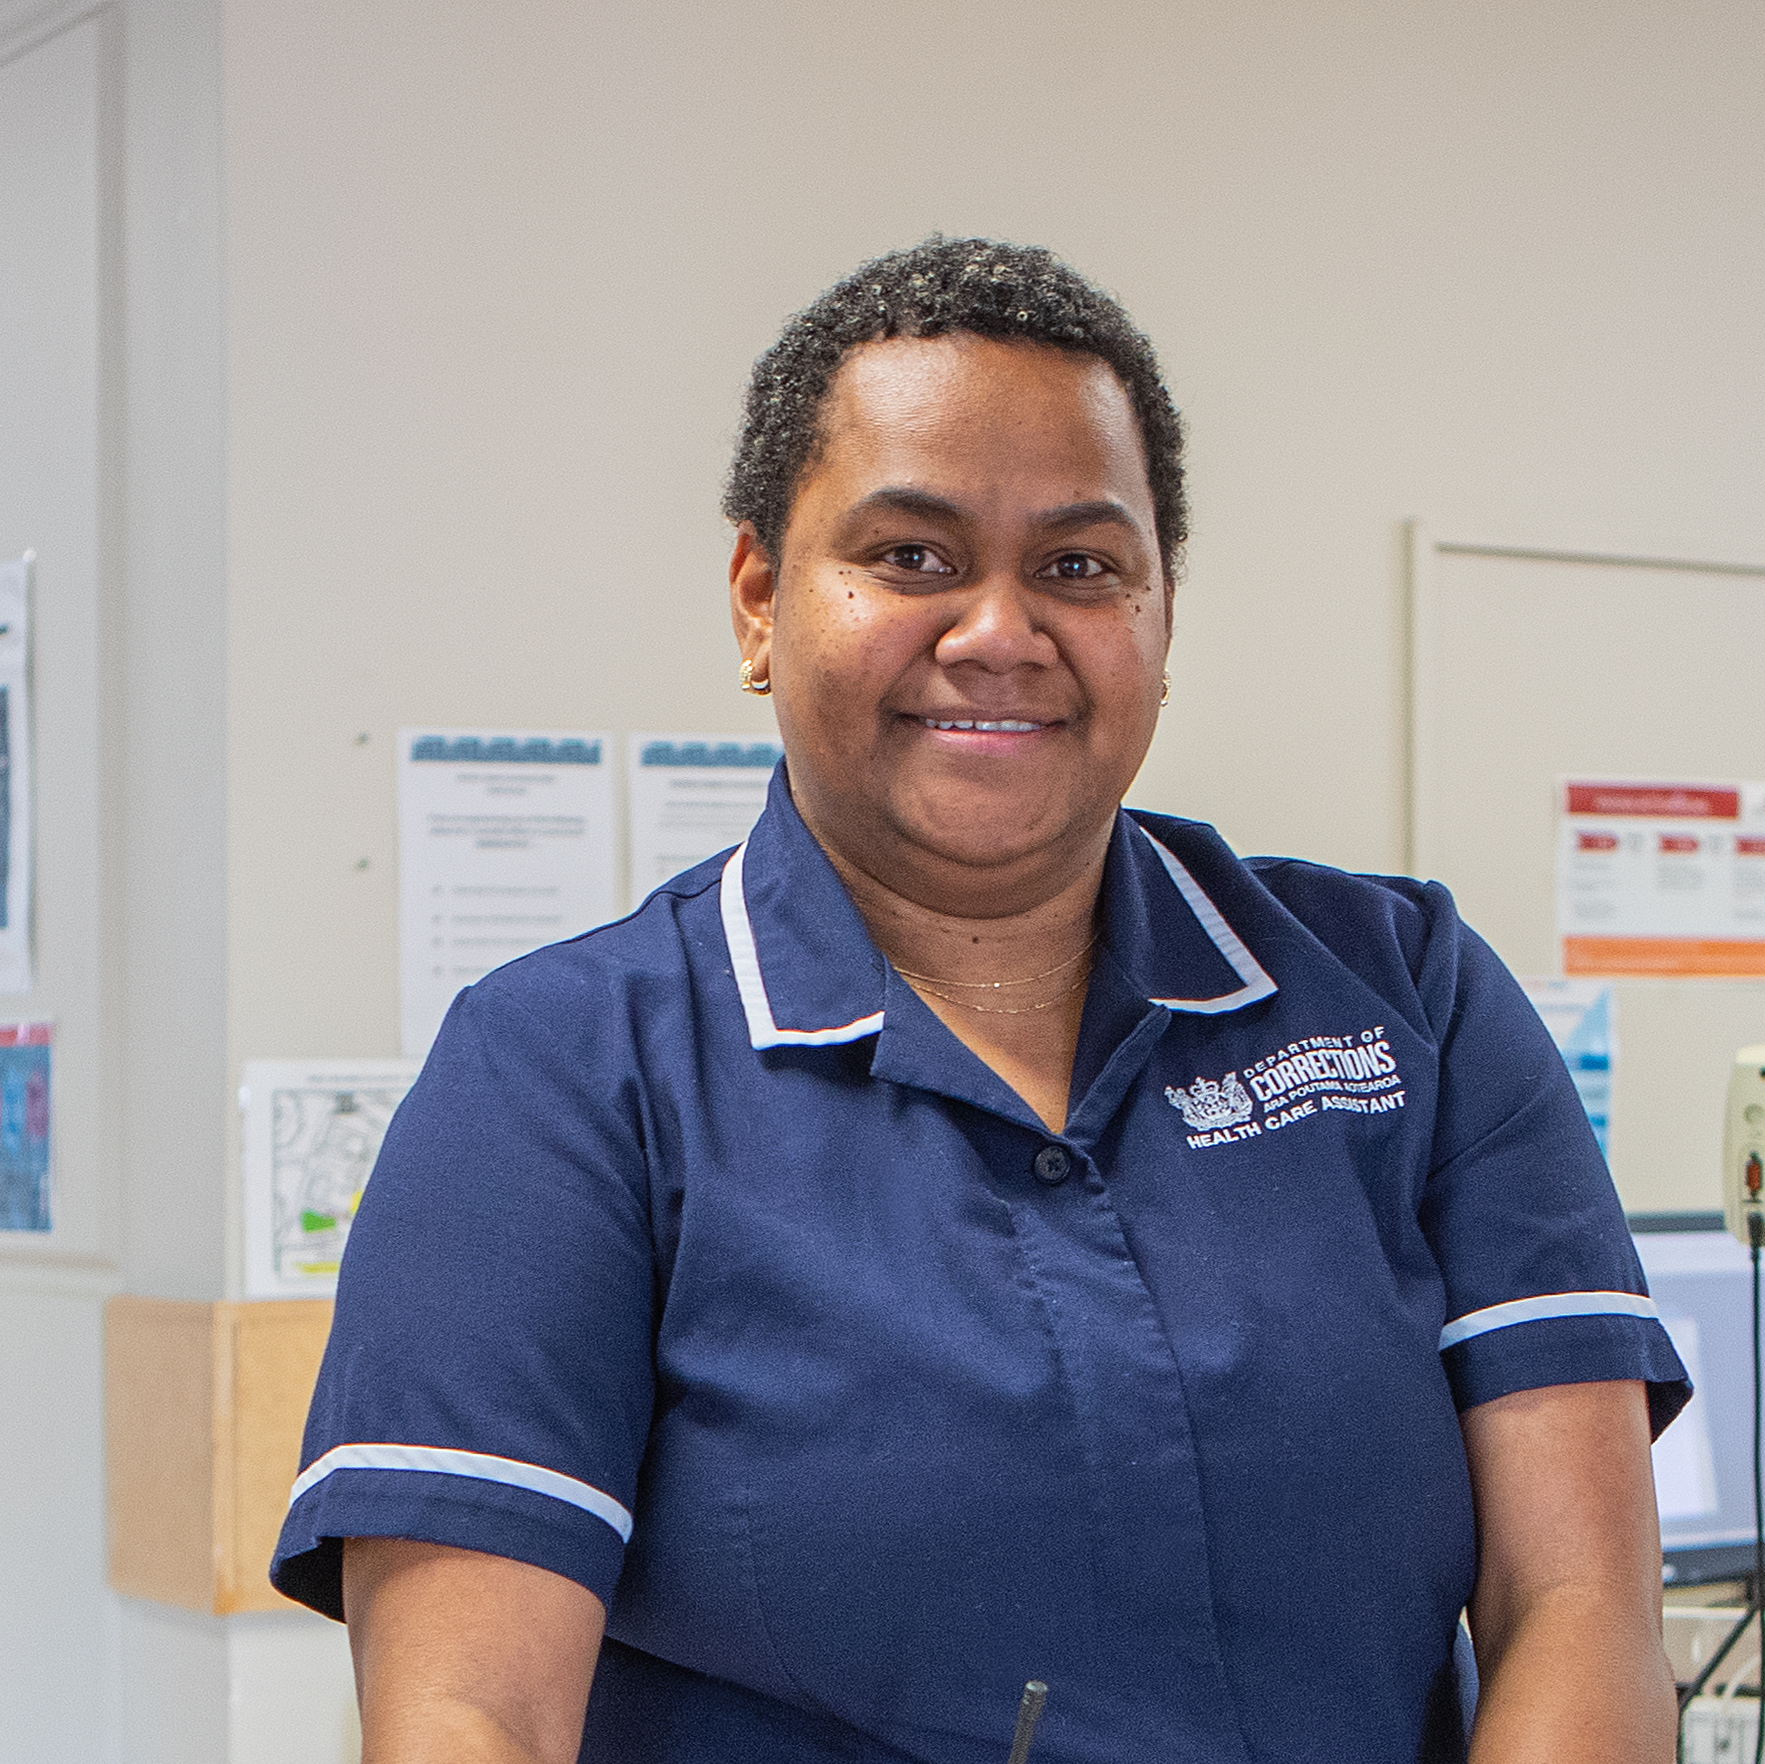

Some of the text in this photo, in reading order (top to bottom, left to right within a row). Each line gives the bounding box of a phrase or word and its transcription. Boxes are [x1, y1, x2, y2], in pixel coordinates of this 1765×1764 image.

[1243, 1026, 1385, 1079] DEPARTMENT OF
[1249, 1041, 1397, 1102] CORRECTIONS
[1186, 1090, 1406, 1149] HEALTH CARE ASSISTANT
[1263, 1096, 1289, 1113] ARA
